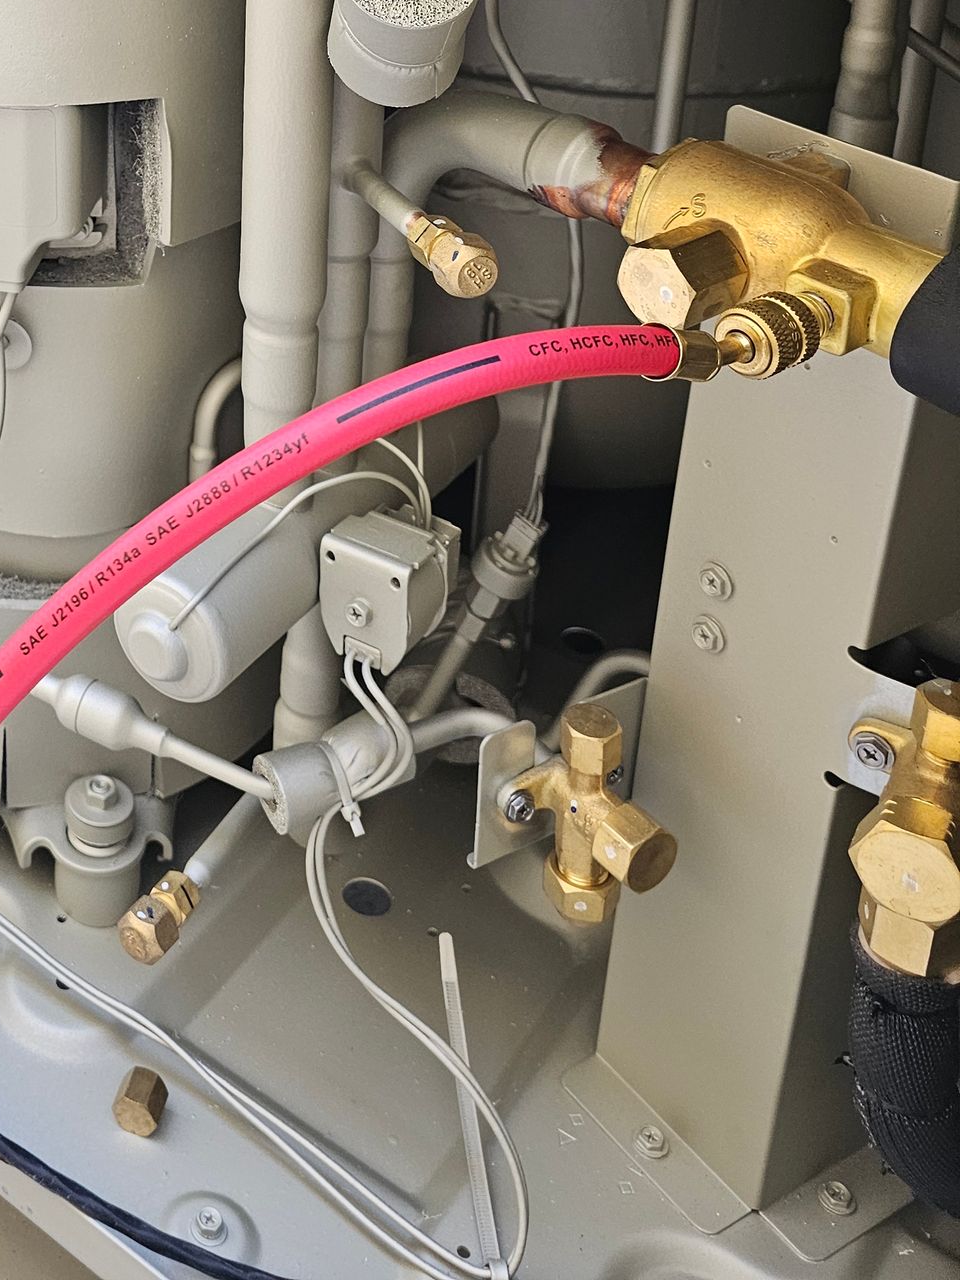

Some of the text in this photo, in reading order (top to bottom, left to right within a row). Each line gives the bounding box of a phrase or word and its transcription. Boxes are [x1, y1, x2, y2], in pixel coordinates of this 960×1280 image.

[690, 192, 707, 218] S
[528, 340, 569, 357] CFC,
[570, 334, 619, 350] HCFC,
[619, 333, 654, 349] HFC,
[19, 625, 49, 656] SAE
[145, 515, 181, 546] SAE
